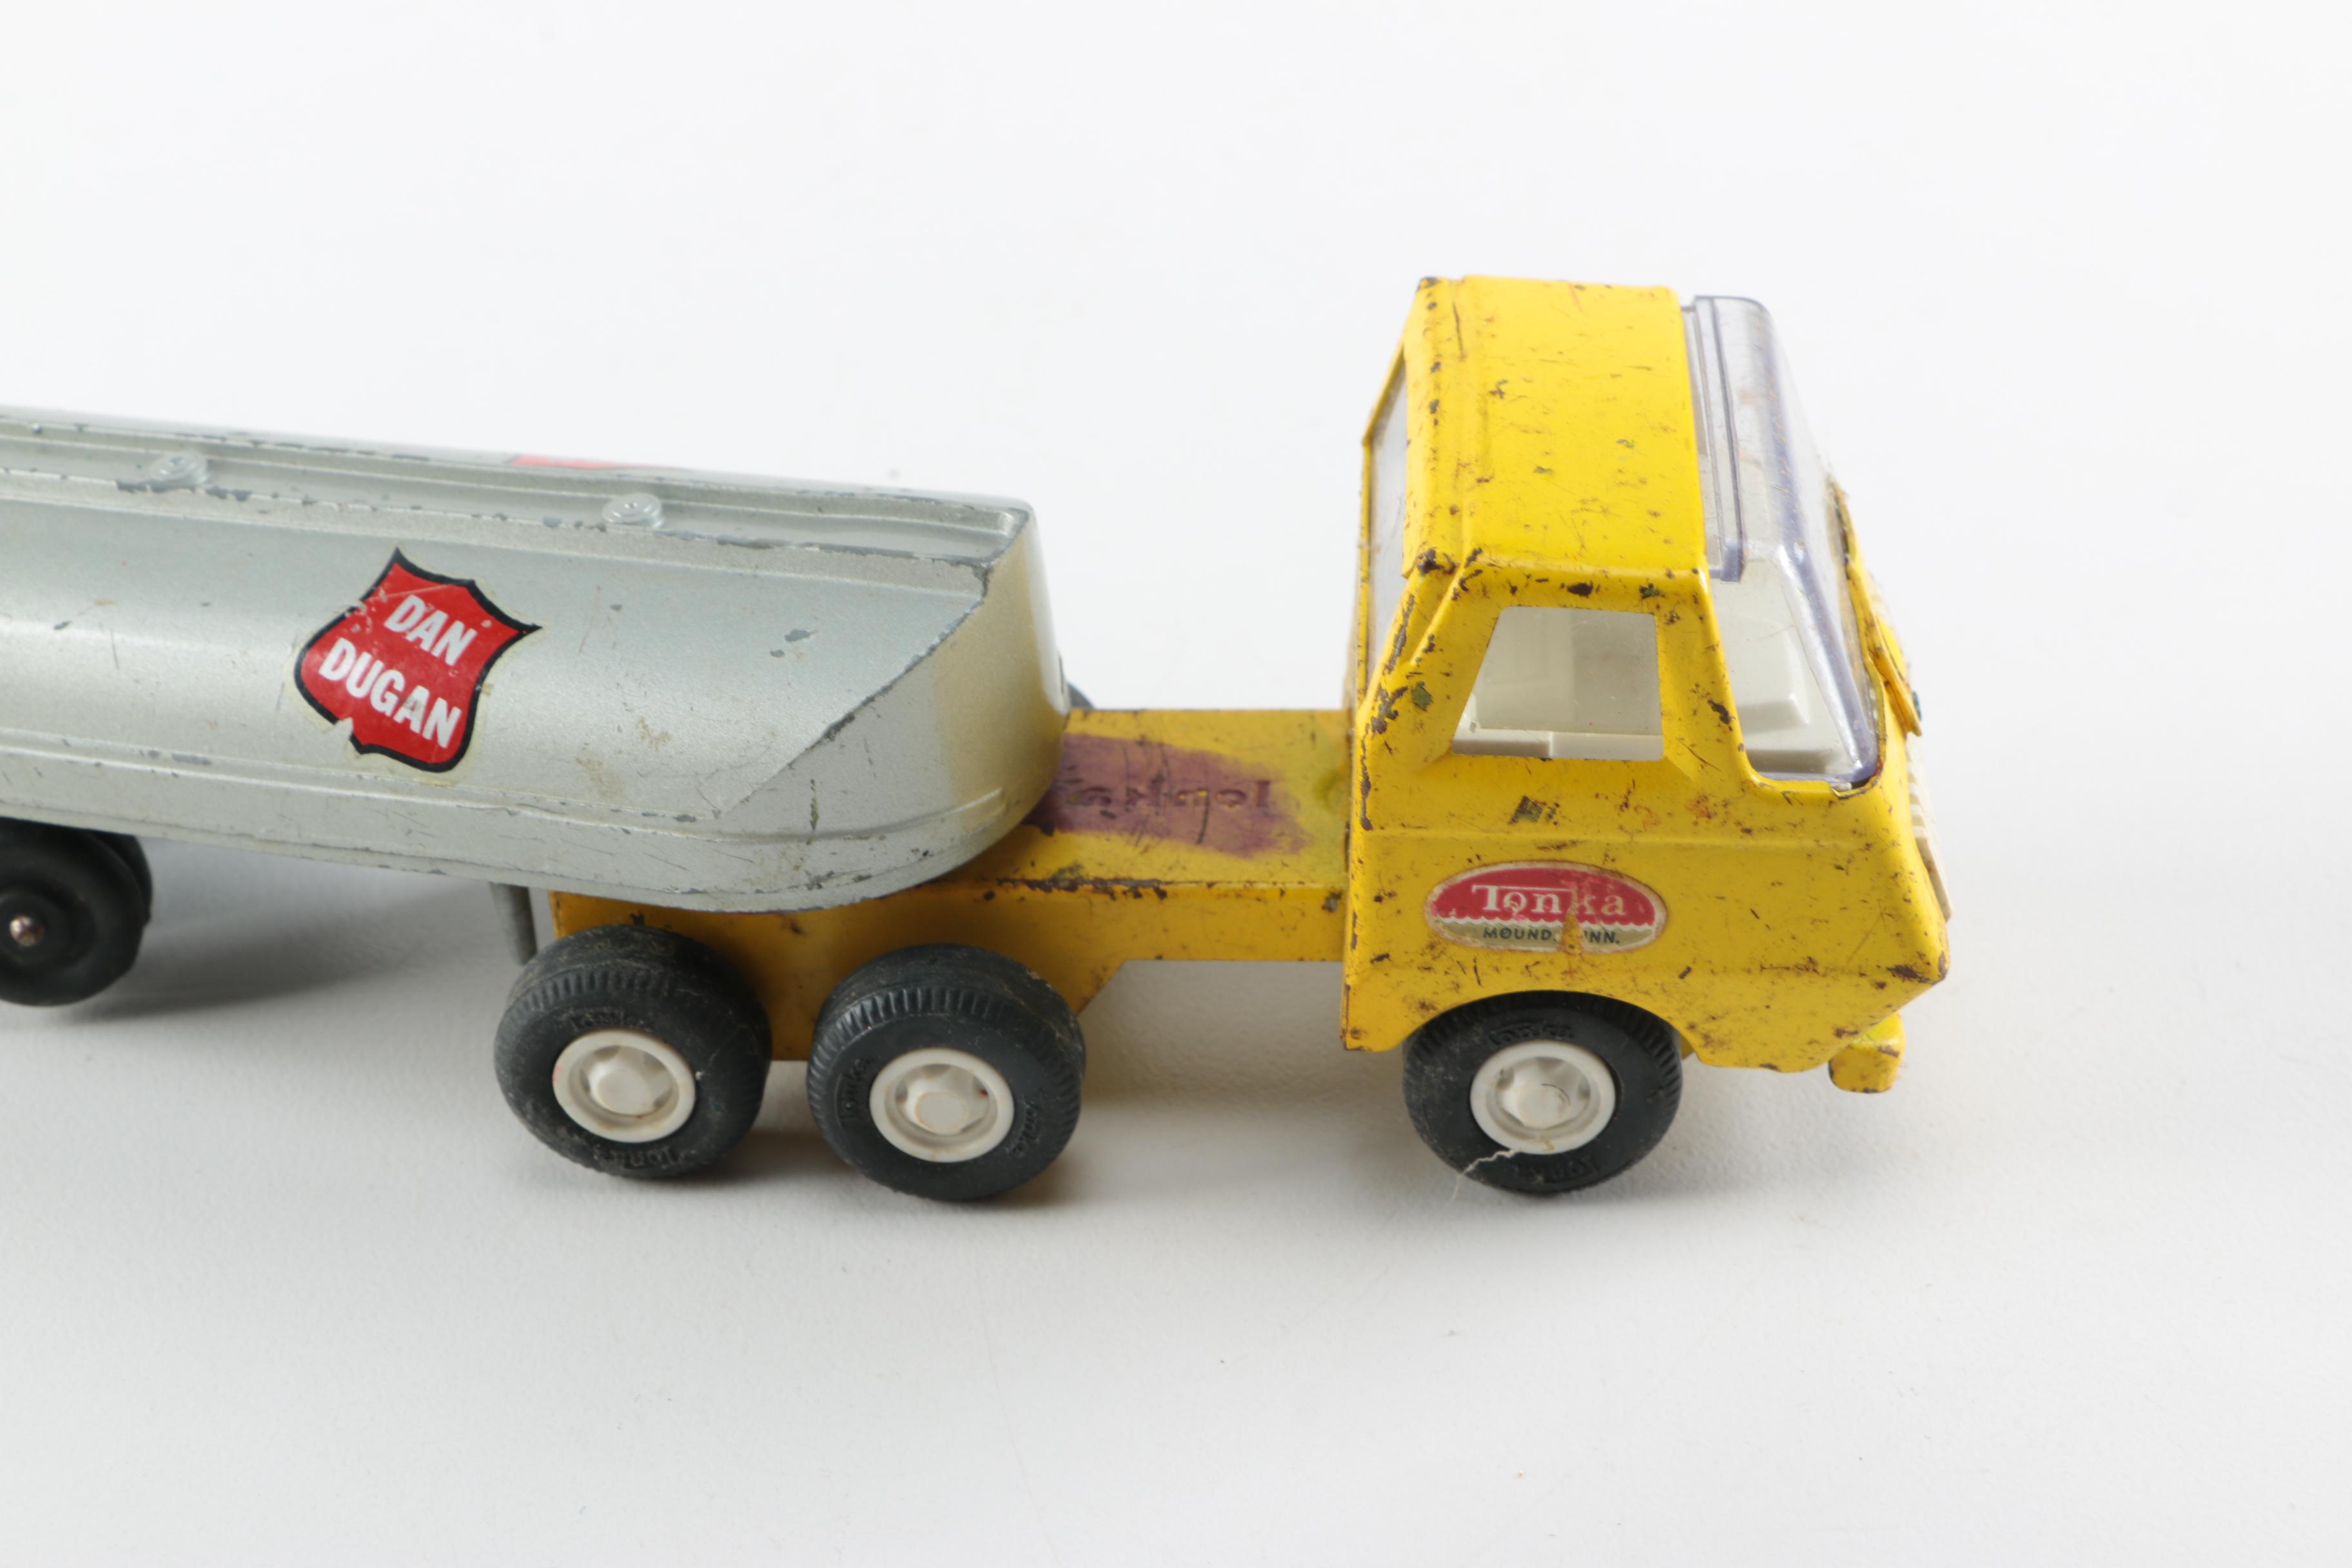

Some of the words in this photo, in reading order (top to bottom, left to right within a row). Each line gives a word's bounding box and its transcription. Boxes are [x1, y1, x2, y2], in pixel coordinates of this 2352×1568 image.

[384, 594, 478, 667] DAN
[318, 637, 462, 749] DUGAN
[1472, 884, 1628, 917] Tonka
